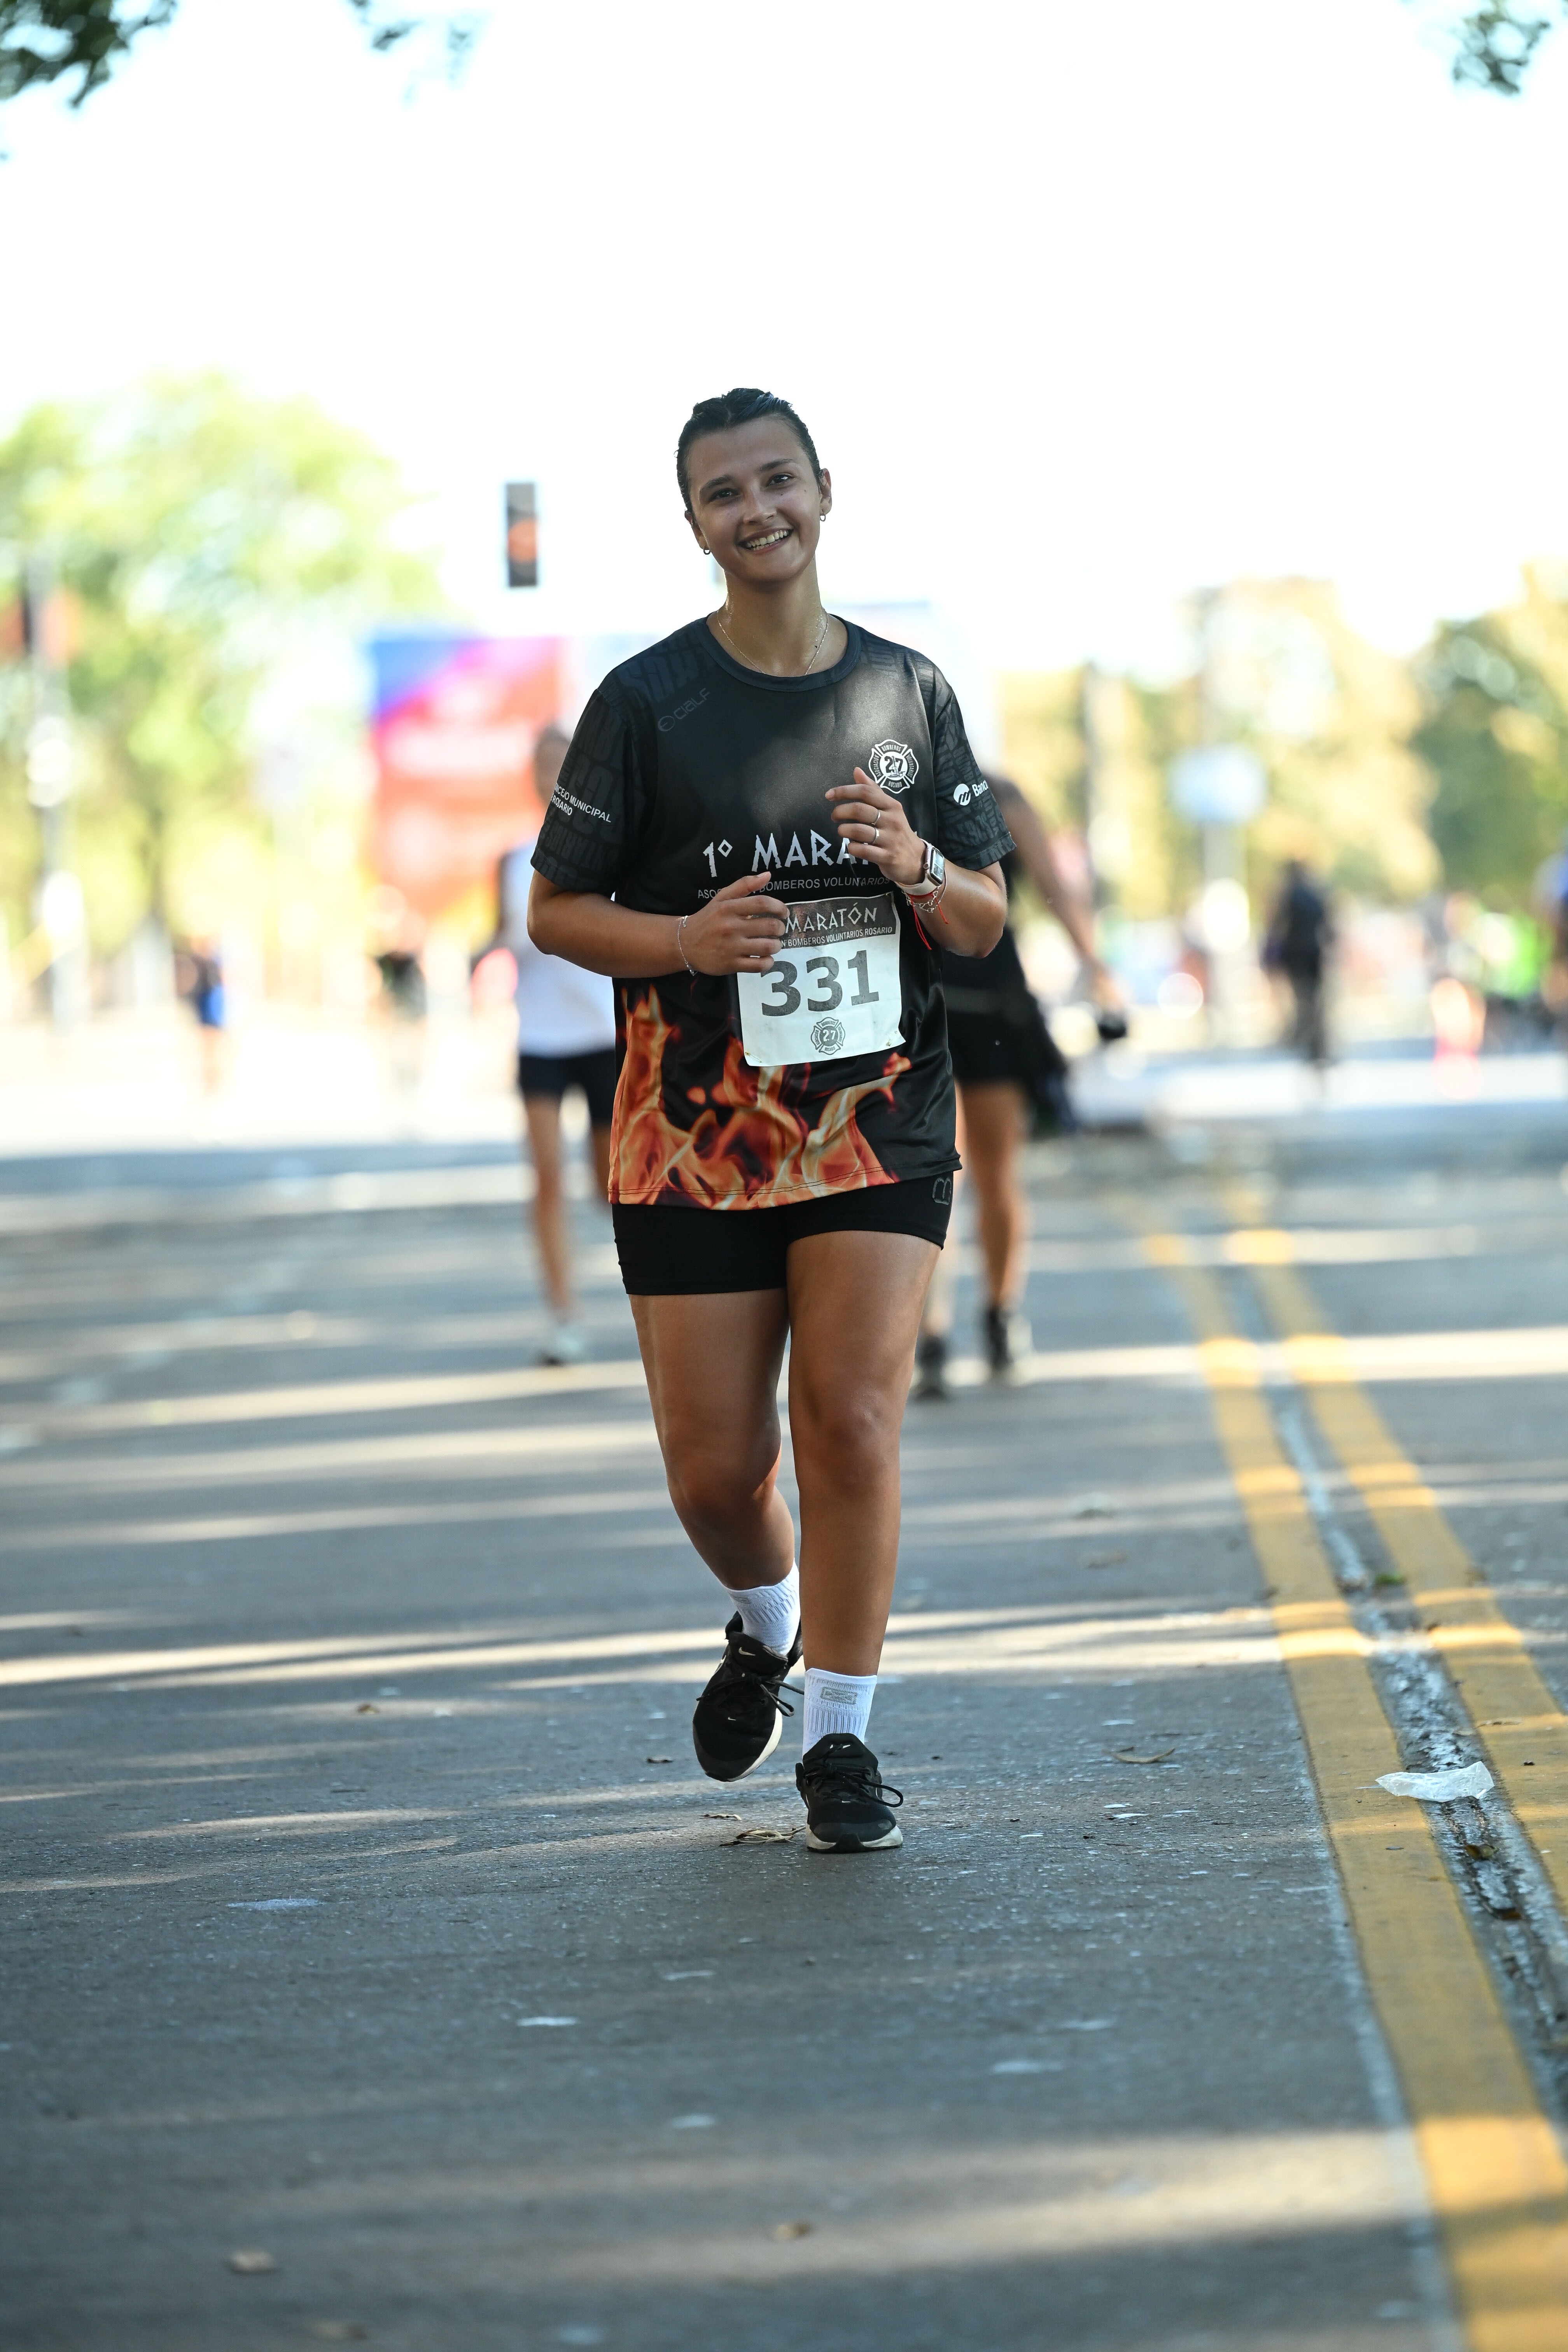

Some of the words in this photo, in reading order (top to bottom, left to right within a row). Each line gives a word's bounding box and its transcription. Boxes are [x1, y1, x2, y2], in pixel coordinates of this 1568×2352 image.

[884, 756, 903, 773] 27
[906, 754, 915, 778] VOLUNTARIOS
[552, 794, 573, 816] ROSARIO
[555, 783, 570, 800] NCEJO
[569, 795, 611, 822] MUNICIPAL
[785, 902, 877, 933] MARATÓN
[788, 936, 825, 947] BOMBEROS
[826, 929, 863, 943] VOLUNTARIOS
[865, 927, 892, 936] ROSARIO
[760, 949, 879, 1017] 331
[823, 1029, 836, 1042] 27
